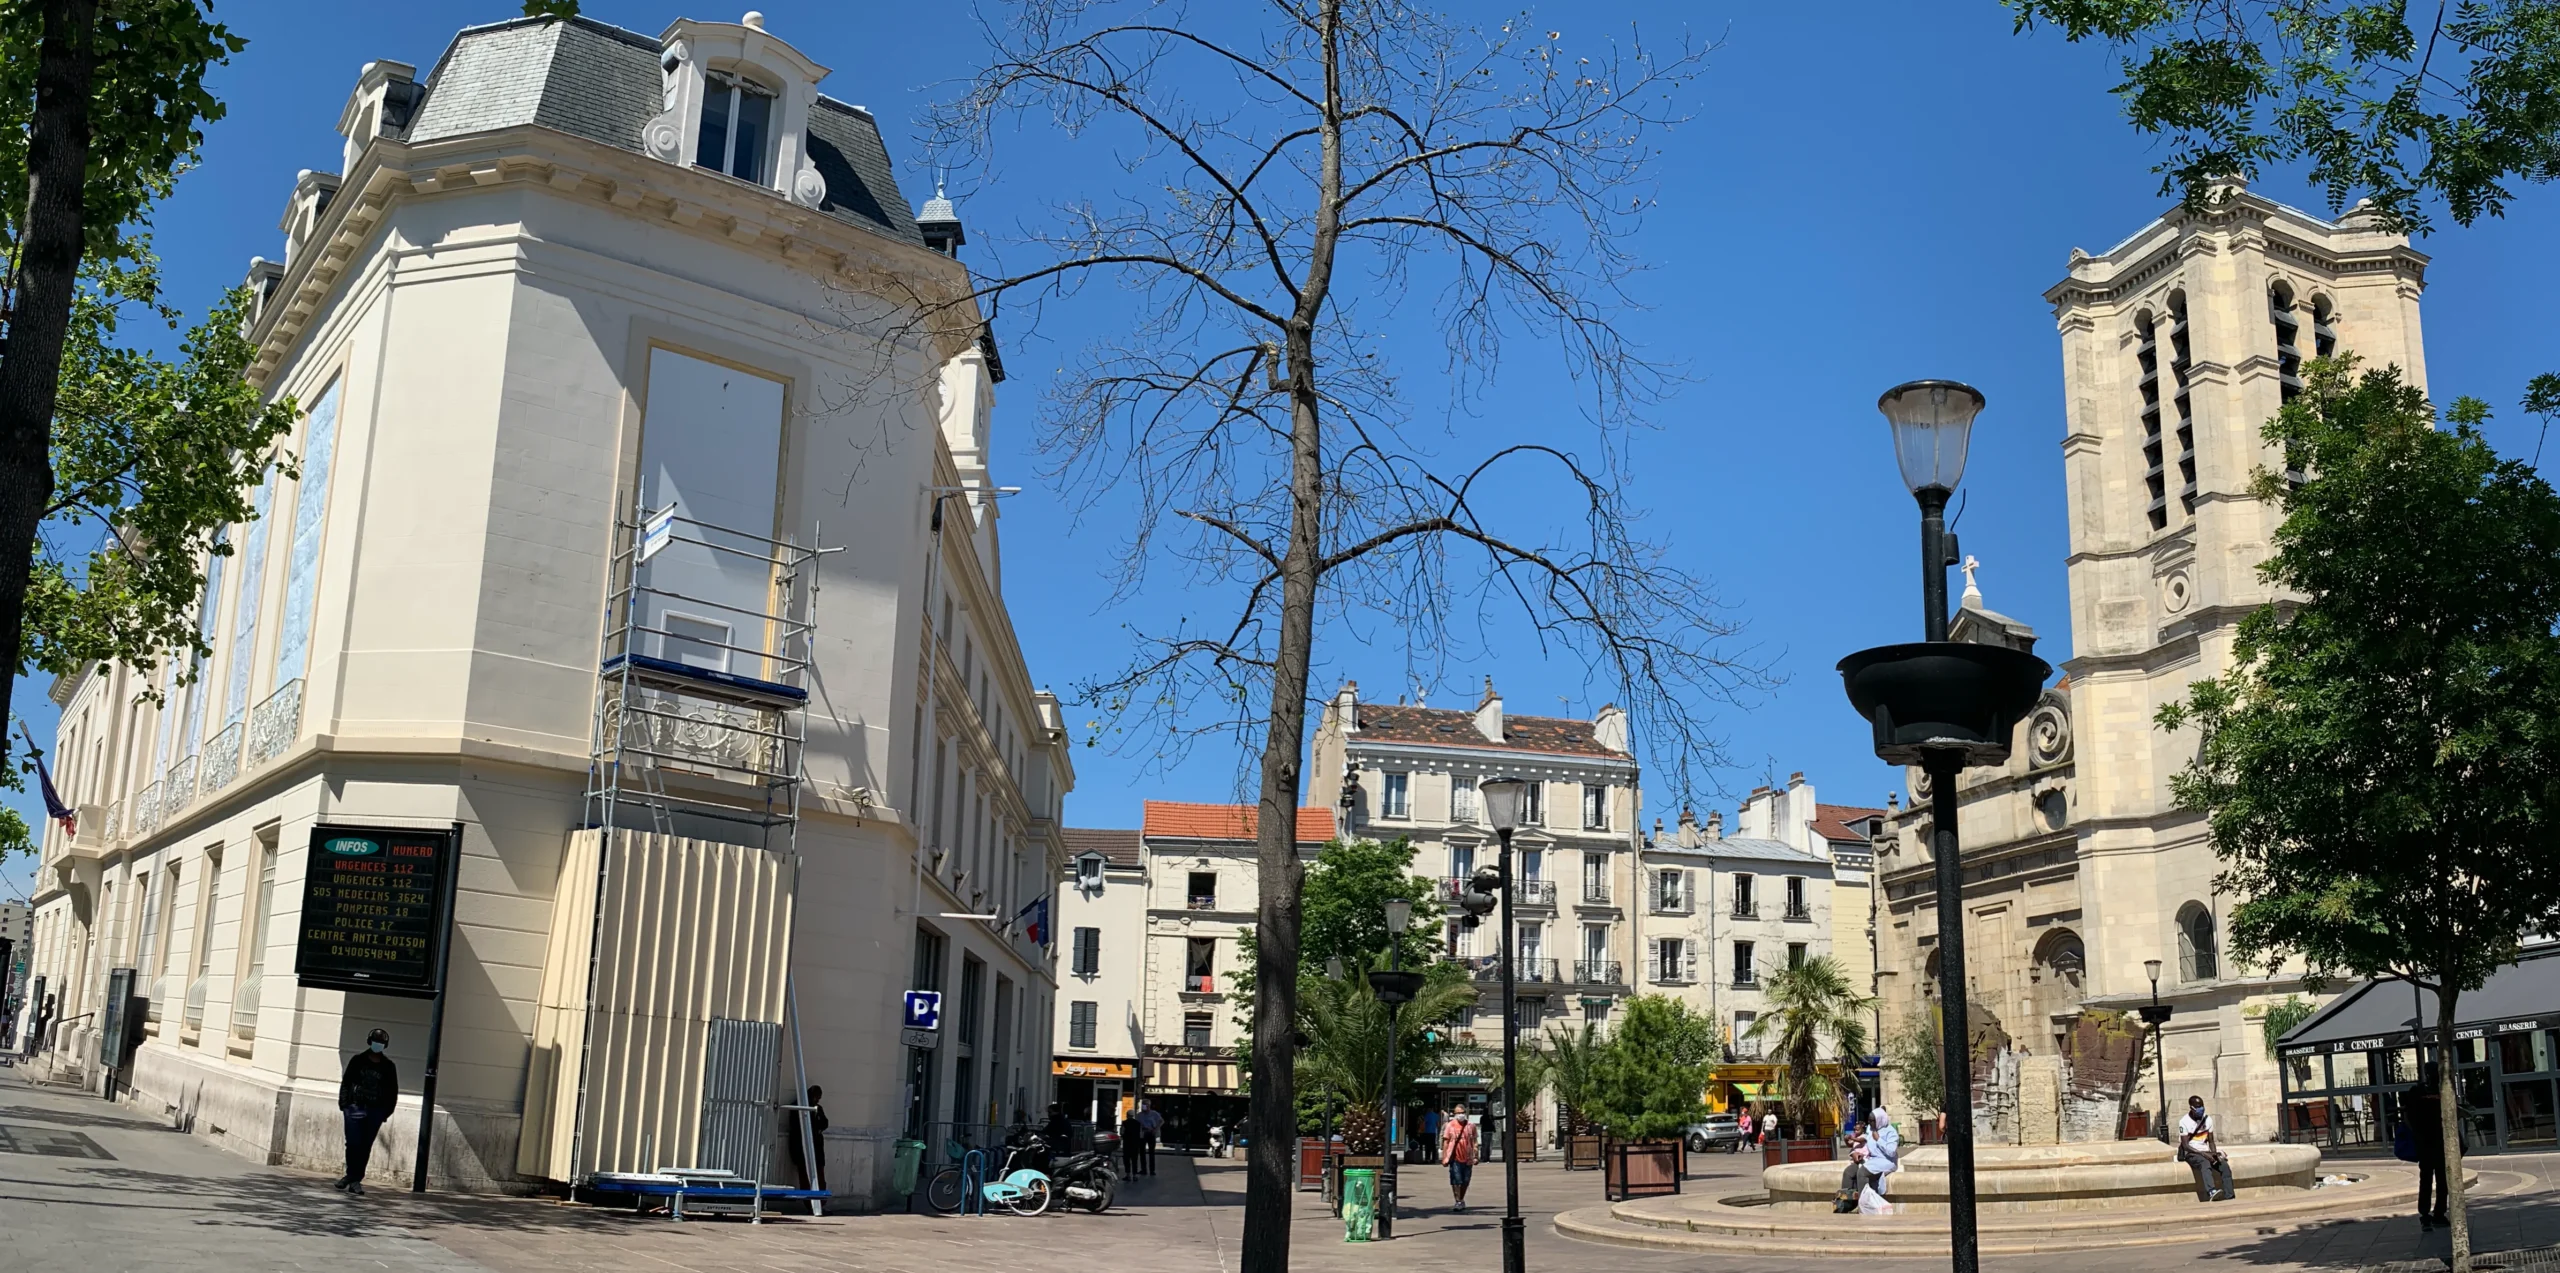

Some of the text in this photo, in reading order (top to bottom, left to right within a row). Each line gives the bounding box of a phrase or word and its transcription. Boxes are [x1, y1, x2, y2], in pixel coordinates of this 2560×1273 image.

[335, 840, 368, 852] INFOS
[393, 845, 433, 857] NUMERO
[335, 860, 414, 874] URGENCES 112
[333, 874, 412, 888] URGENCES 112
[313, 887, 424, 904] SOS MEDECINS 3624
[336, 903, 409, 917] POMPIERS 18
[335, 917, 394, 930] POLICE 17
[308, 929, 426, 948] CENTRE ANTI POISON
[331, 945, 397, 960] 0140054848
[914, 998, 930, 1020] P
[2499, 1021, 2538, 1032] BRASSERIE
[2456, 1029, 2484, 1040] CENTRE
[2285, 1038, 2384, 1056] BRASSERIE LE CENTRE
